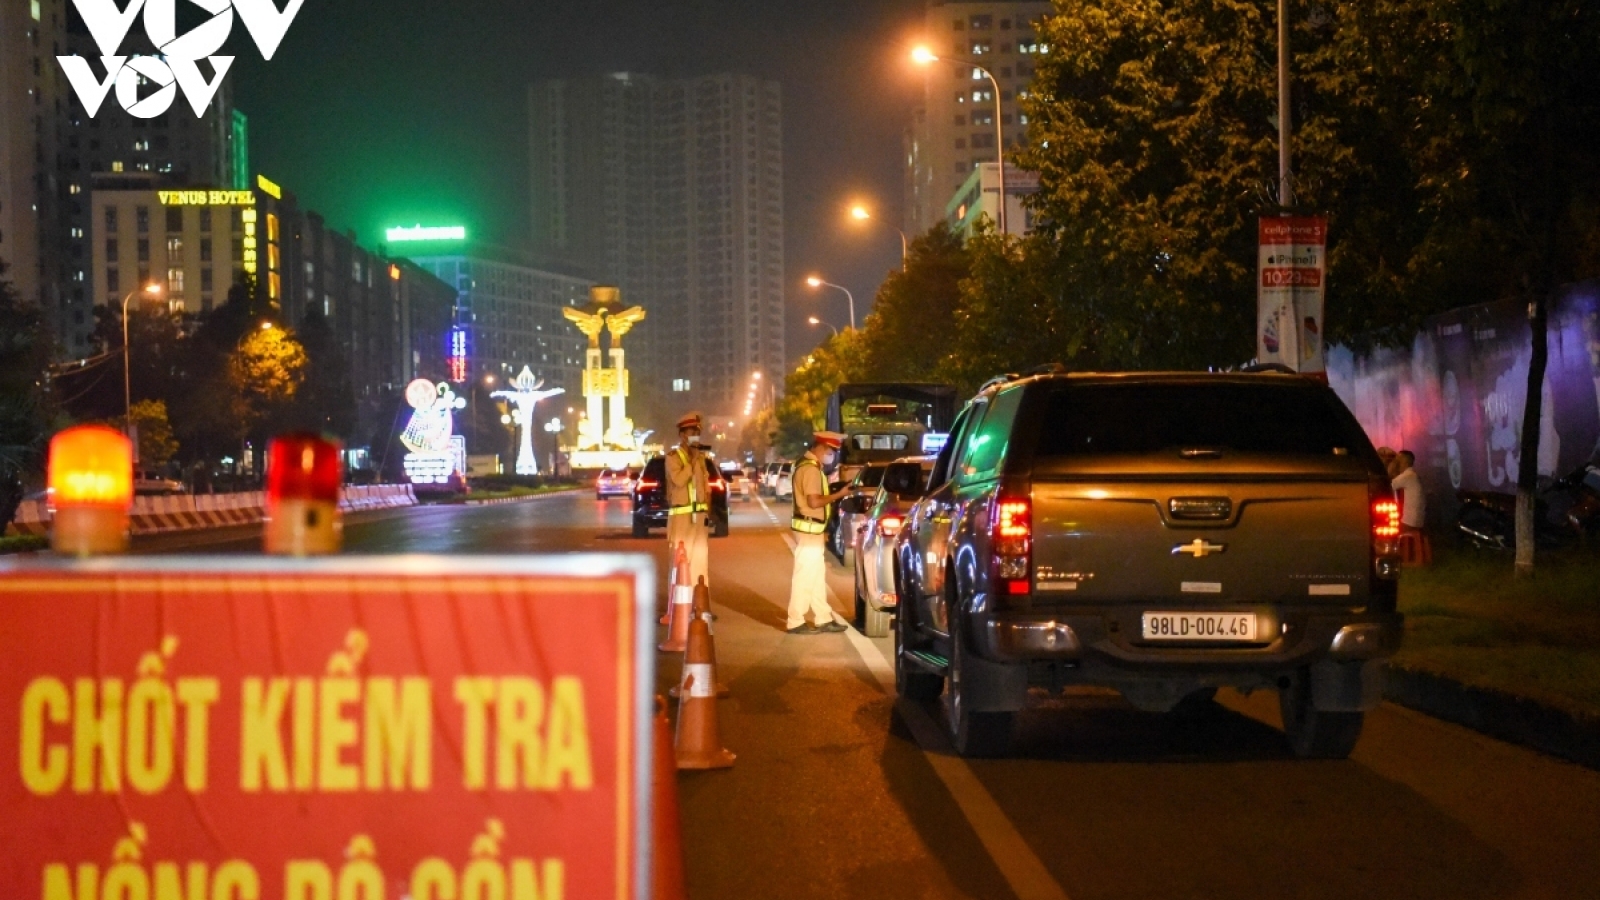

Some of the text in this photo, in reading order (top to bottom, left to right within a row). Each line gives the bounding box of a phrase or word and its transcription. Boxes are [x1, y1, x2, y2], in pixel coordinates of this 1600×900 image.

[158, 190, 256, 205] VENUS HOTEL
[1150, 616, 1248, 636] 98LD-004.46
[20, 628, 593, 795] CHỐT KIỂM TRA
